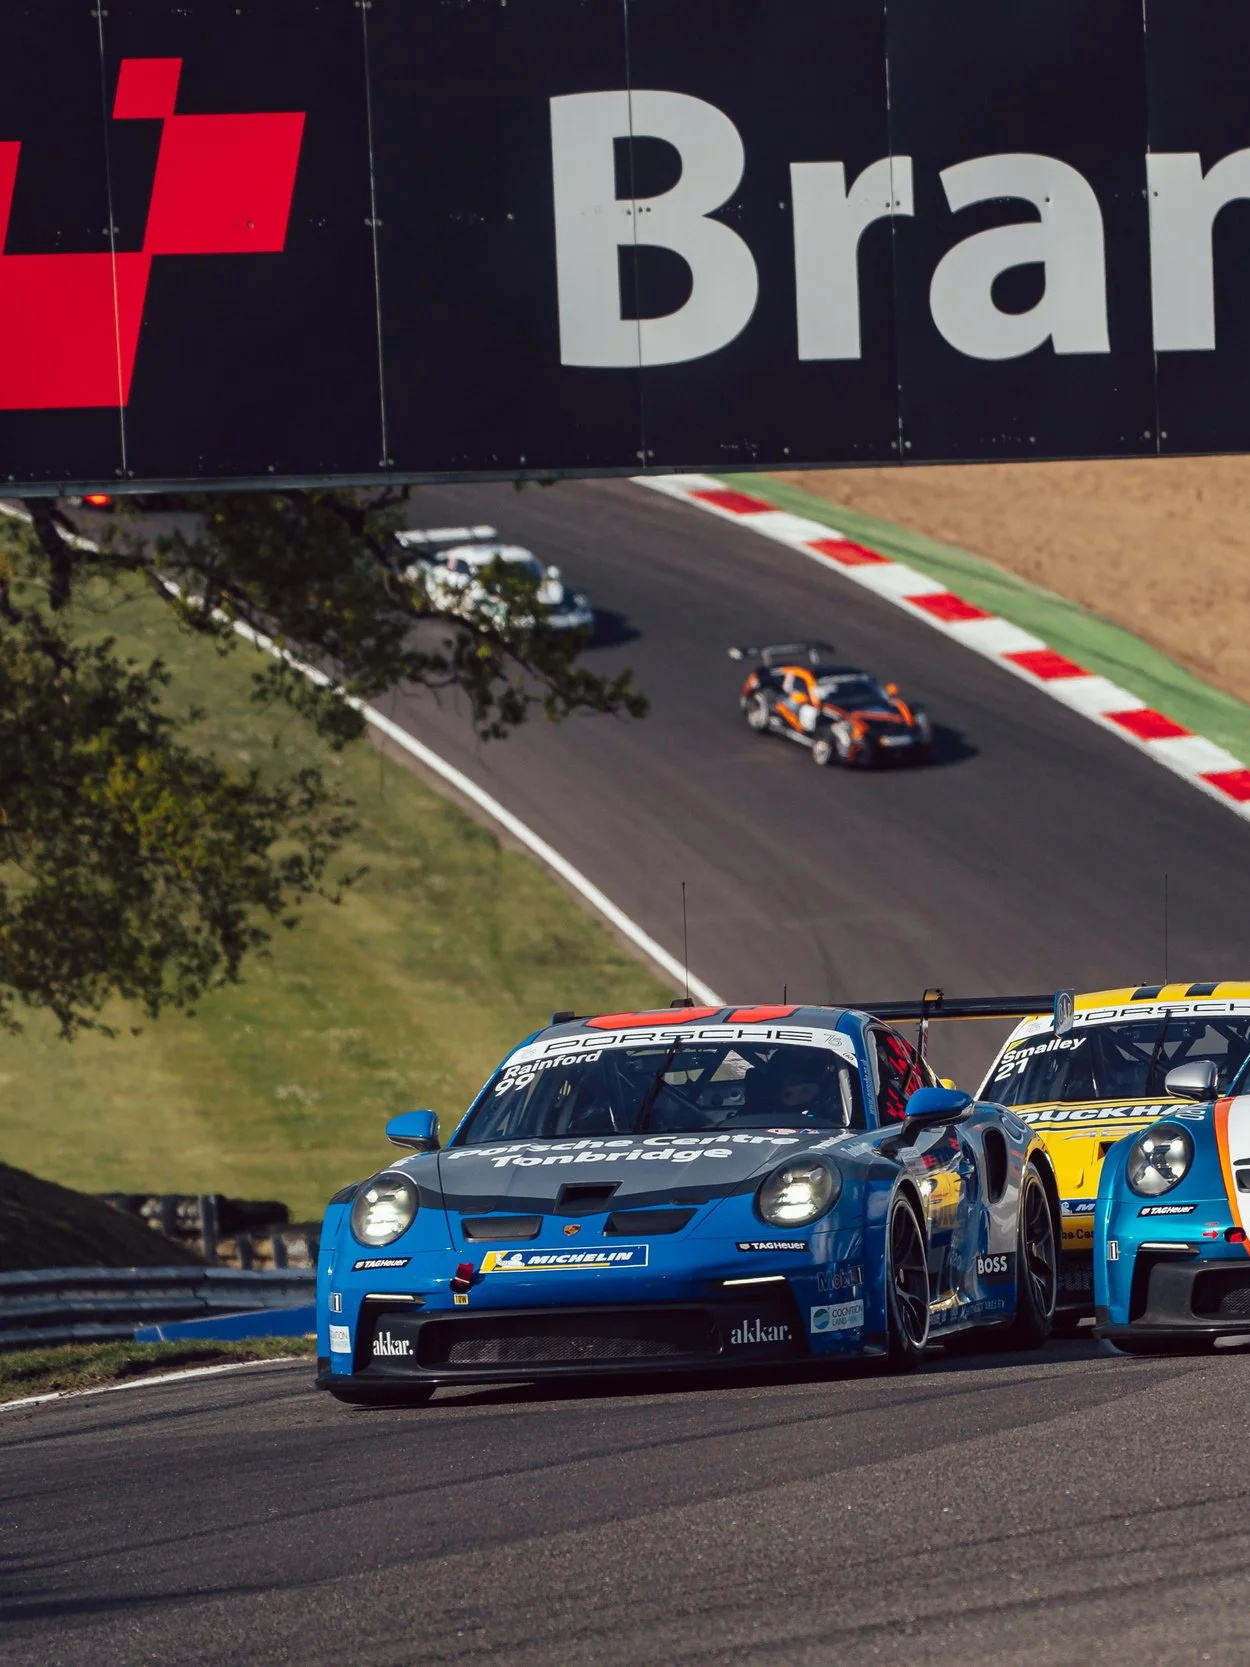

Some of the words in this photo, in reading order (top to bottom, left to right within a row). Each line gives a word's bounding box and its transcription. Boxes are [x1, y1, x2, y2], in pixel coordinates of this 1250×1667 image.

[546, 1028, 814, 1053] PORSCHE
[1000, 1036, 1088, 1066] Smalley
[502, 1050, 604, 1080] Rainford
[994, 1059, 1030, 1083] 21
[494, 1072, 537, 1098] 99
[447, 1139, 634, 1161] Porsche
[642, 1134, 800, 1147] Centre
[491, 1147, 733, 1170] Tonbridge
[528, 1251, 634, 1265] MICHELIN
[977, 1255, 1008, 1275] BOSS
[373, 1331, 414, 1356] akkar.
[731, 1318, 793, 1345] akkar.
